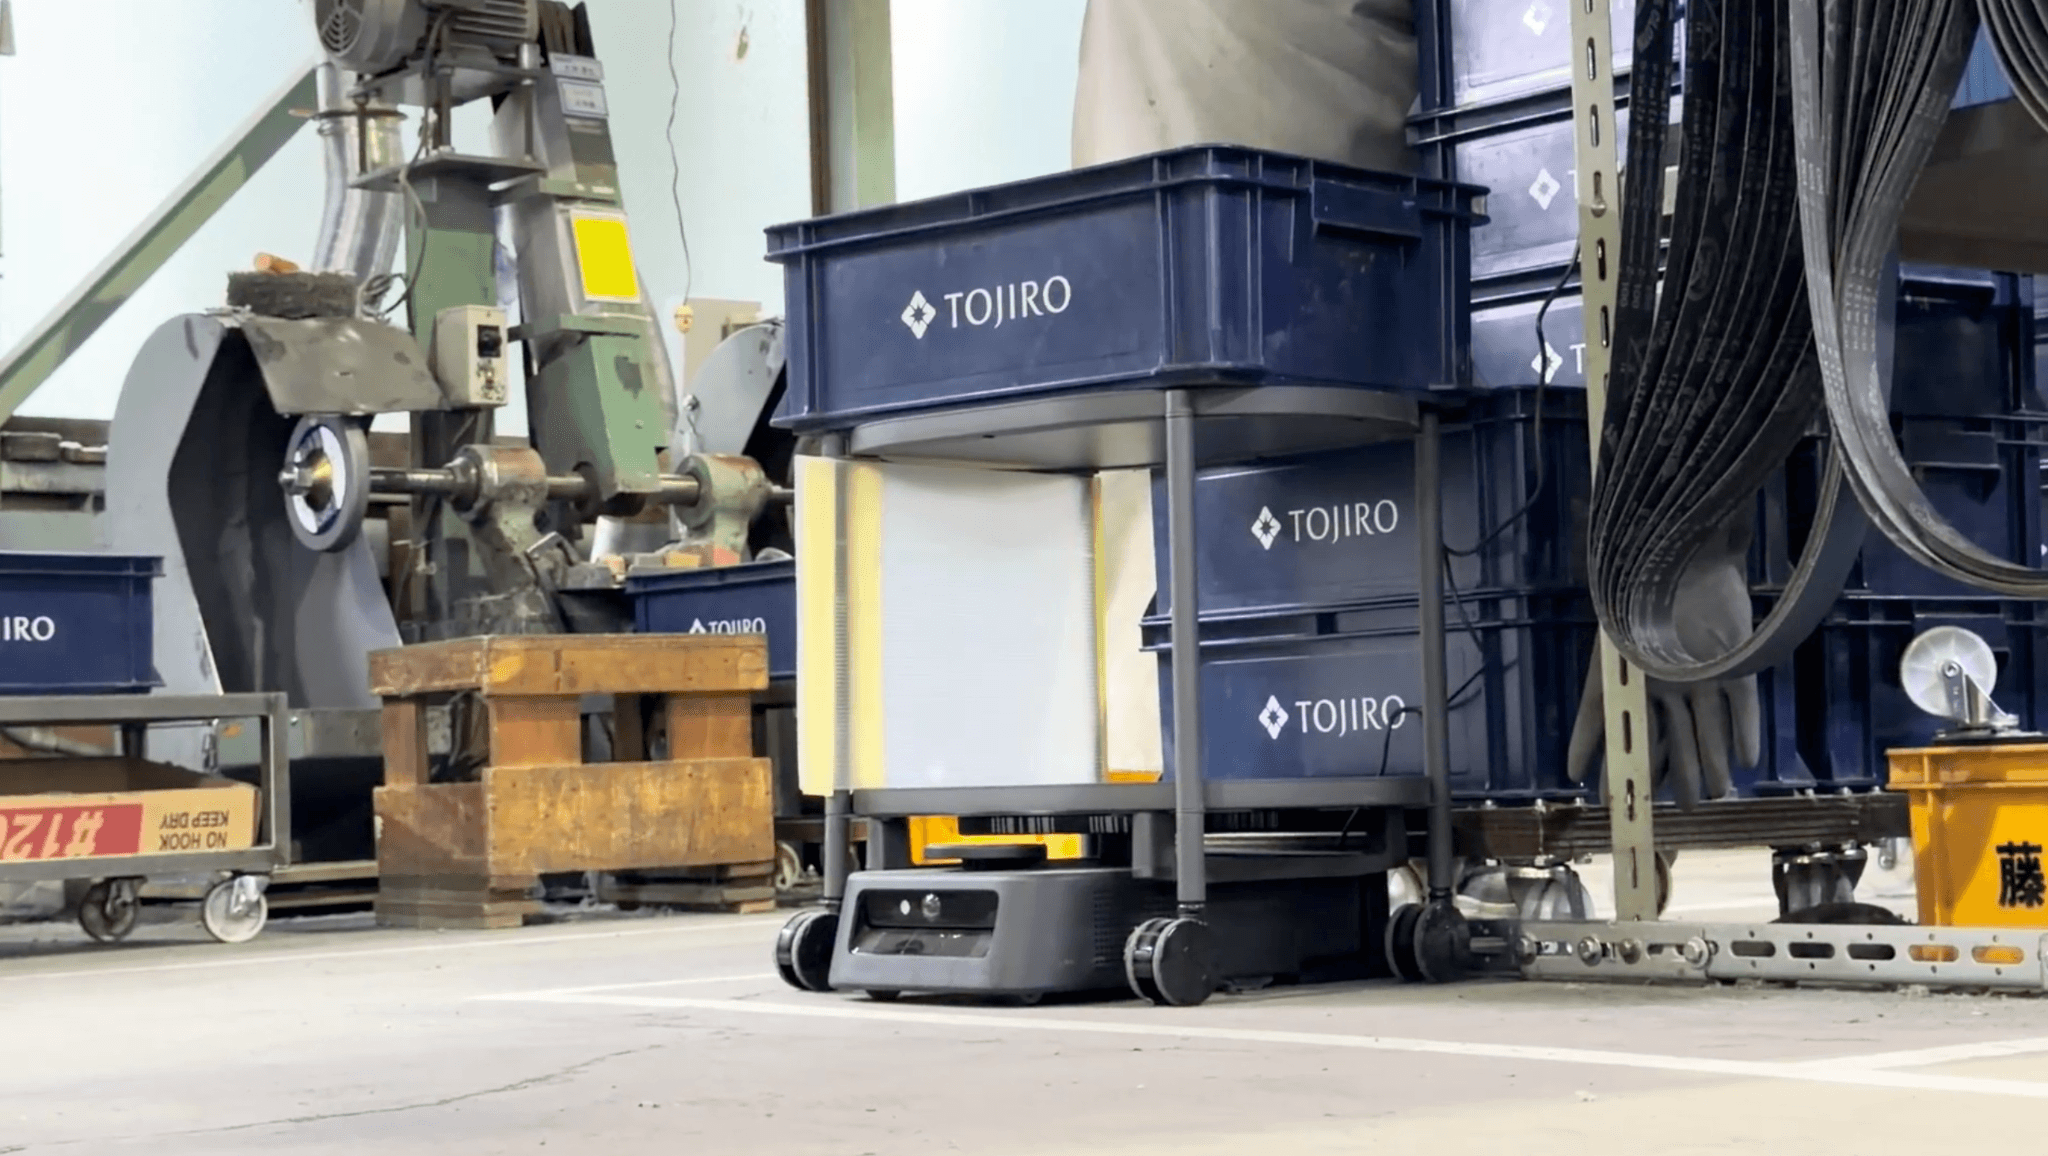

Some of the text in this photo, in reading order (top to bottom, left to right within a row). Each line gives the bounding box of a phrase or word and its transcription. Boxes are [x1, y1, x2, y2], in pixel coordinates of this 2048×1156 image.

[943, 275, 1072, 329] TOJIRO
[1288, 499, 1398, 544] TOJIRO
[2, 616, 56, 642] IRO
[1294, 694, 1406, 737] TOJIRO
[0, 809, 105, 860] #12
[159, 810, 230, 830] KEEP DRY
[159, 831, 228, 852] NO HOOK
[1996, 840, 2046, 908] 藤
